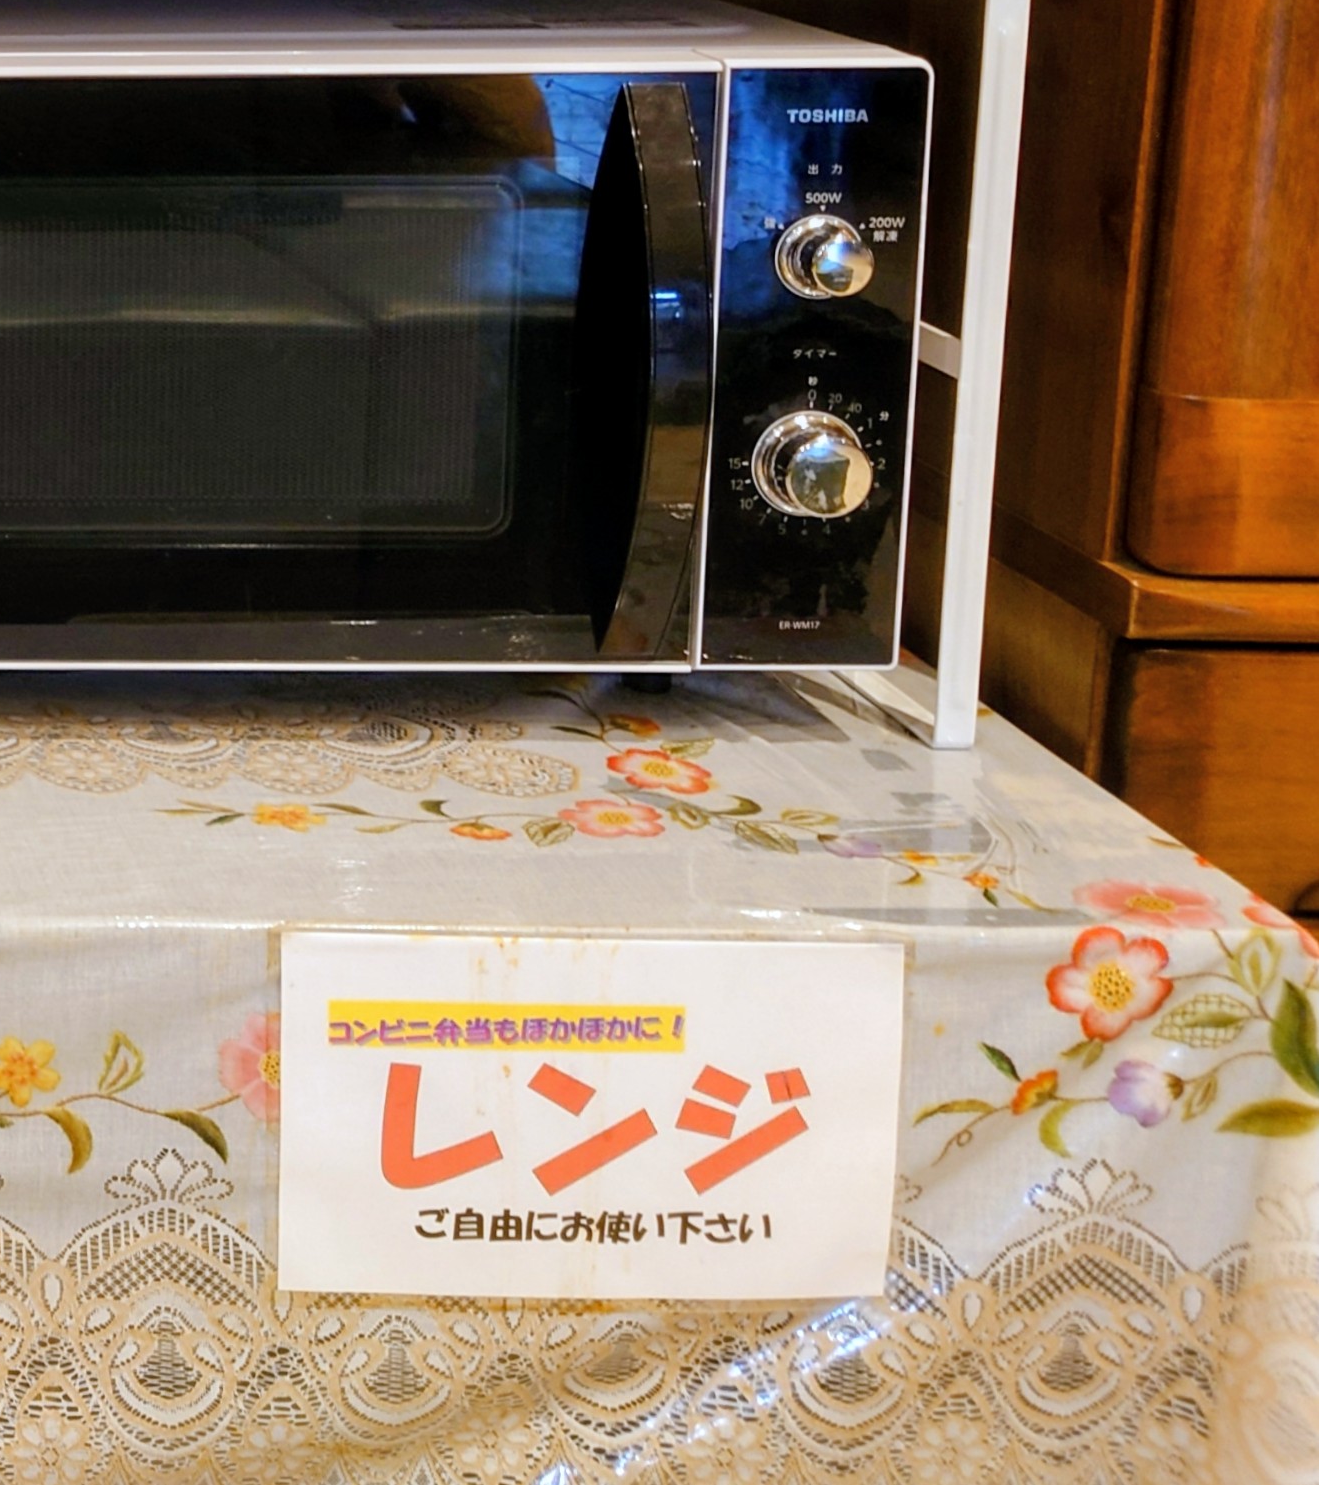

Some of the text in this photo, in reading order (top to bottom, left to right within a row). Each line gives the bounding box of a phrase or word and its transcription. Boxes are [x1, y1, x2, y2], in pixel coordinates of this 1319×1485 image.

[787, 109, 869, 123] TOSHIBA
[805, 192, 843, 204] 500W
[869, 217, 906, 229] 200W
[792, 349, 838, 359] タイマー
[828, 392, 843, 404] 20
[848, 402, 862, 413] 40
[728, 458, 742, 469] 15
[877, 459, 886, 469] 2
[730, 479, 744, 490] 12
[739, 499, 754, 510] 10
[381, 1062, 812, 1197] レンジ
[414, 1208, 773, 1246] ご自由にお使い下さい
